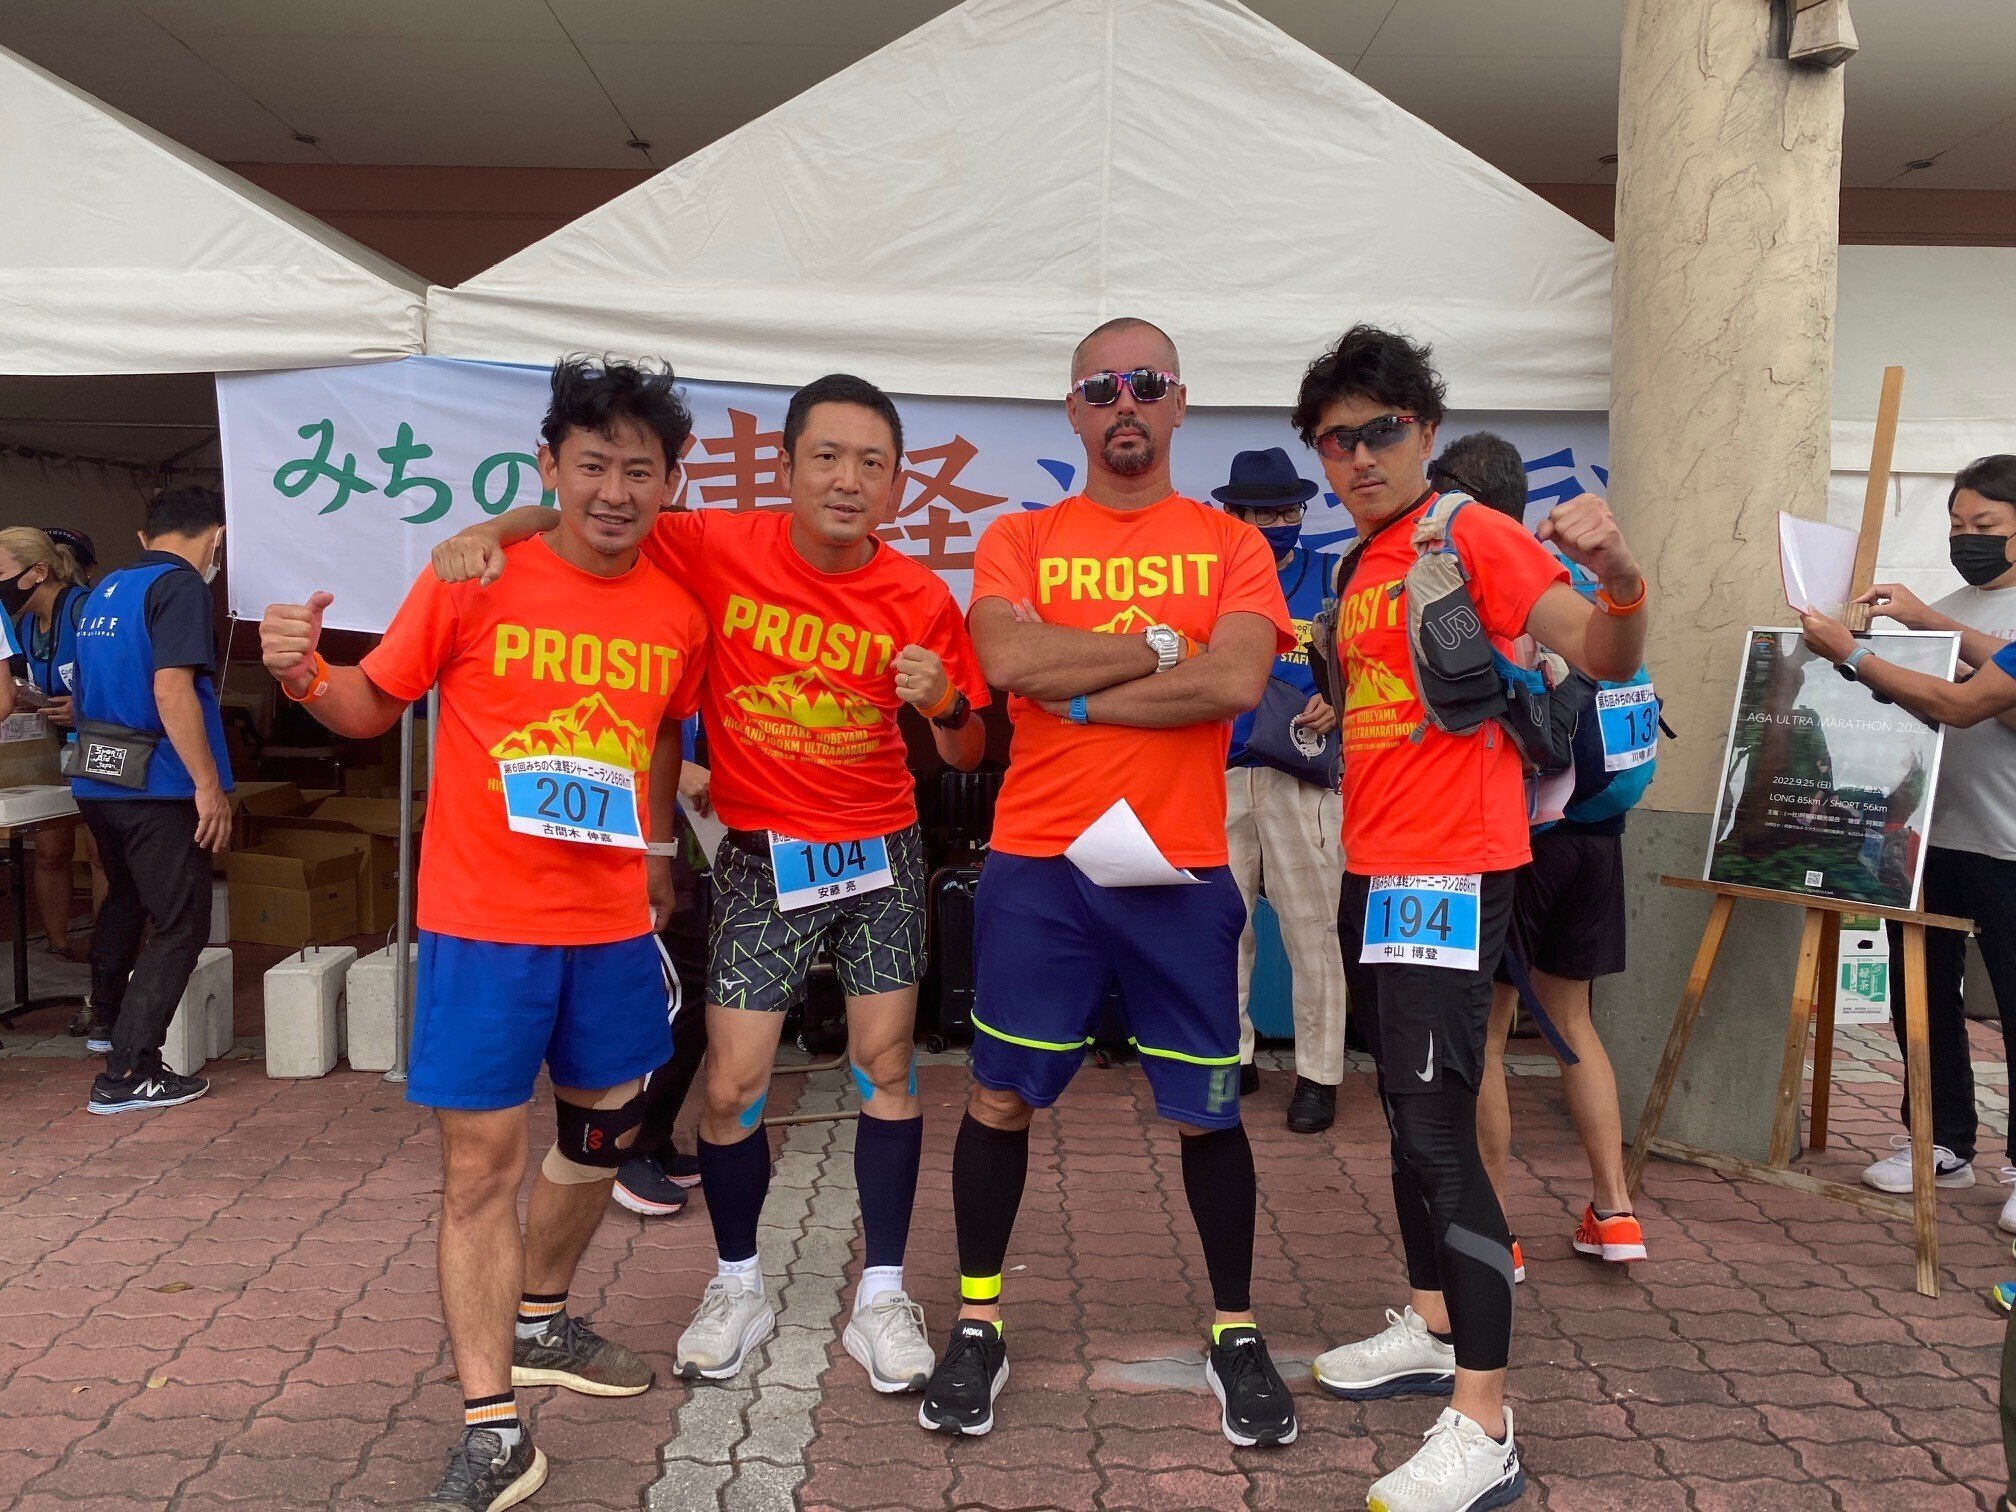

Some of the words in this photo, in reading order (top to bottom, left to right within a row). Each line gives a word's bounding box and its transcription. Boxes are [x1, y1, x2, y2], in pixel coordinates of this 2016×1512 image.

[1039, 553, 1218, 604] PROSIT
[80, 617, 118, 630] TAFF
[723, 594, 895, 676] PROSIT
[493, 623, 678, 696] PROSIT
[1747, 713, 1773, 724] AGA
[1776, 714, 1814, 726] ULTRA
[1817, 717, 1892, 732] MARATHON
[1896, 722, 1929, 734] 2022
[1772, 776, 1815, 787] 2022.9.25
[536, 777, 610, 827] 207
[1769, 793, 1795, 803] LONG
[1797, 796, 1821, 806] 85km
[1830, 800, 1861, 810] SHORT
[1863, 803, 1888, 813] 56km
[542, 823, 581, 839] 古間木
[800, 839, 867, 883] 104
[818, 884, 841, 899] 安藤
[845, 880, 857, 893] 亮
[1382, 895, 1452, 941] 194
[1384, 945, 1404, 958] 中山
[1411, 945, 1438, 961] 博登
[962, 1326, 983, 1338] HOKA
